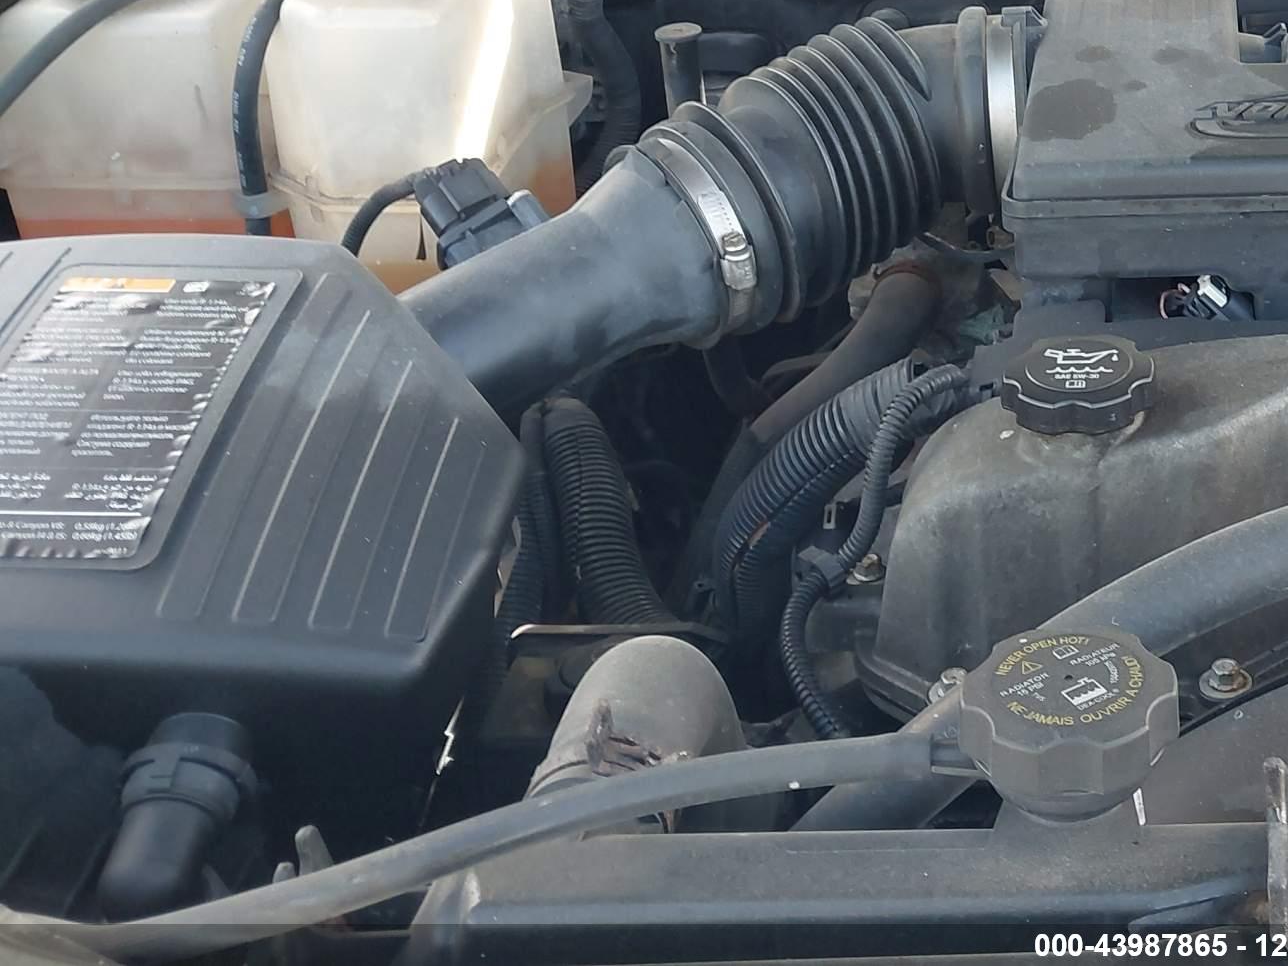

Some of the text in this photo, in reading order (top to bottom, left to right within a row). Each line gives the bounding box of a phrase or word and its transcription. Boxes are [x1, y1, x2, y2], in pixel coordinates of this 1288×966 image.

[996, 635, 1089, 675] NEVER OPEN HOT!
[1069, 642, 1122, 666] RADIATEUR
[999, 671, 1051, 698] RADIATOR
[1007, 701, 1029, 716] NE
[1023, 710, 1075, 726] JAMAIS
[1080, 697, 1133, 723] OUVRIR
[1126, 689, 1139, 698] A
